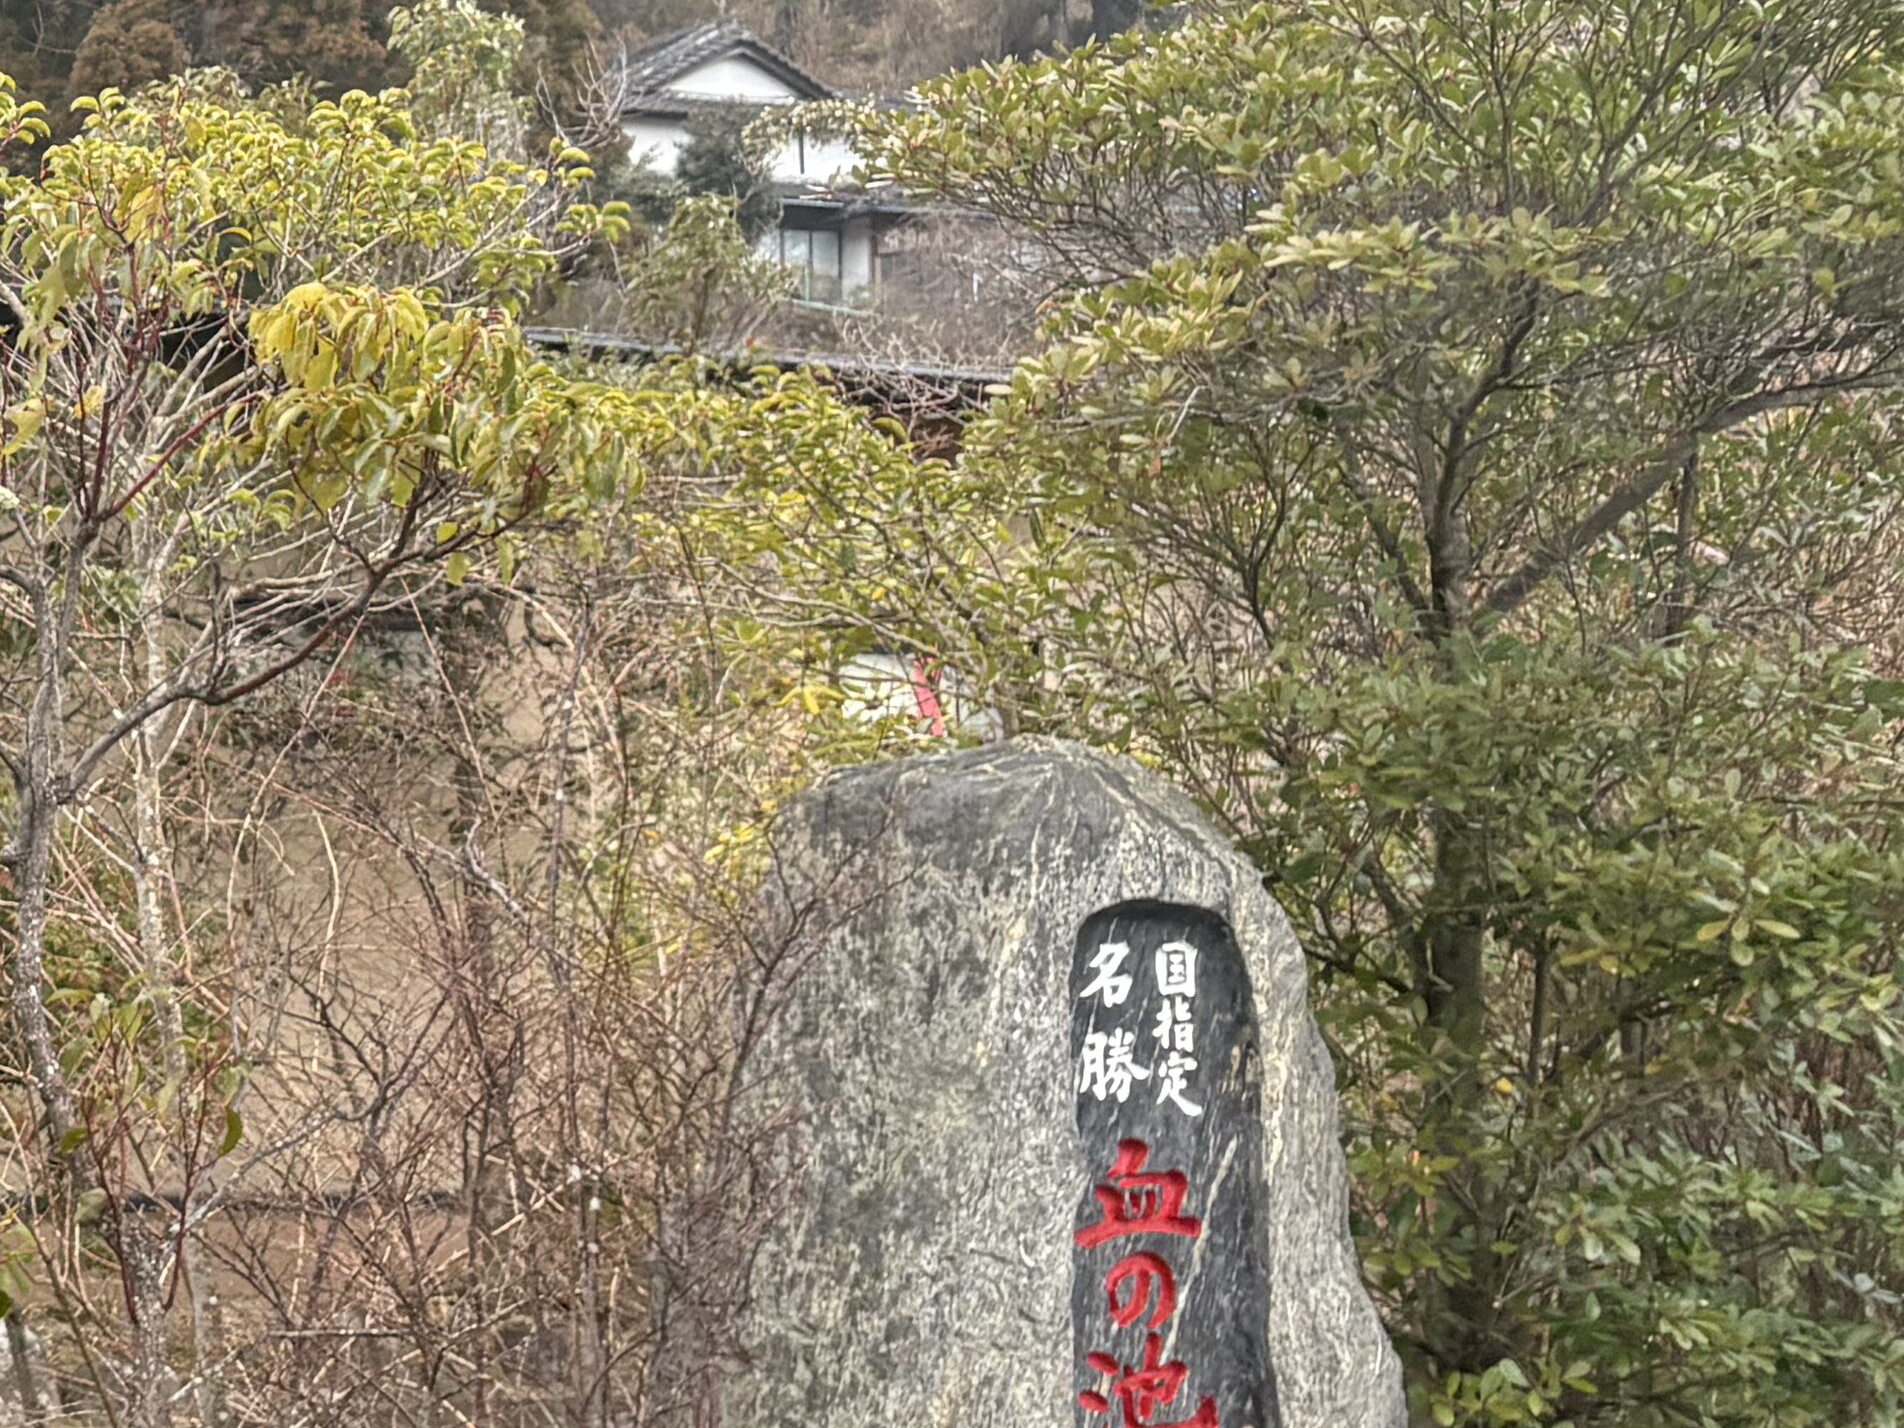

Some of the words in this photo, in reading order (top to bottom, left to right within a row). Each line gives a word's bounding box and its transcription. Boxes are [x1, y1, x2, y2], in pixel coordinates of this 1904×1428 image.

[1079, 941, 1151, 1104] 名勝
[1152, 941, 1203, 1117] 国指定
